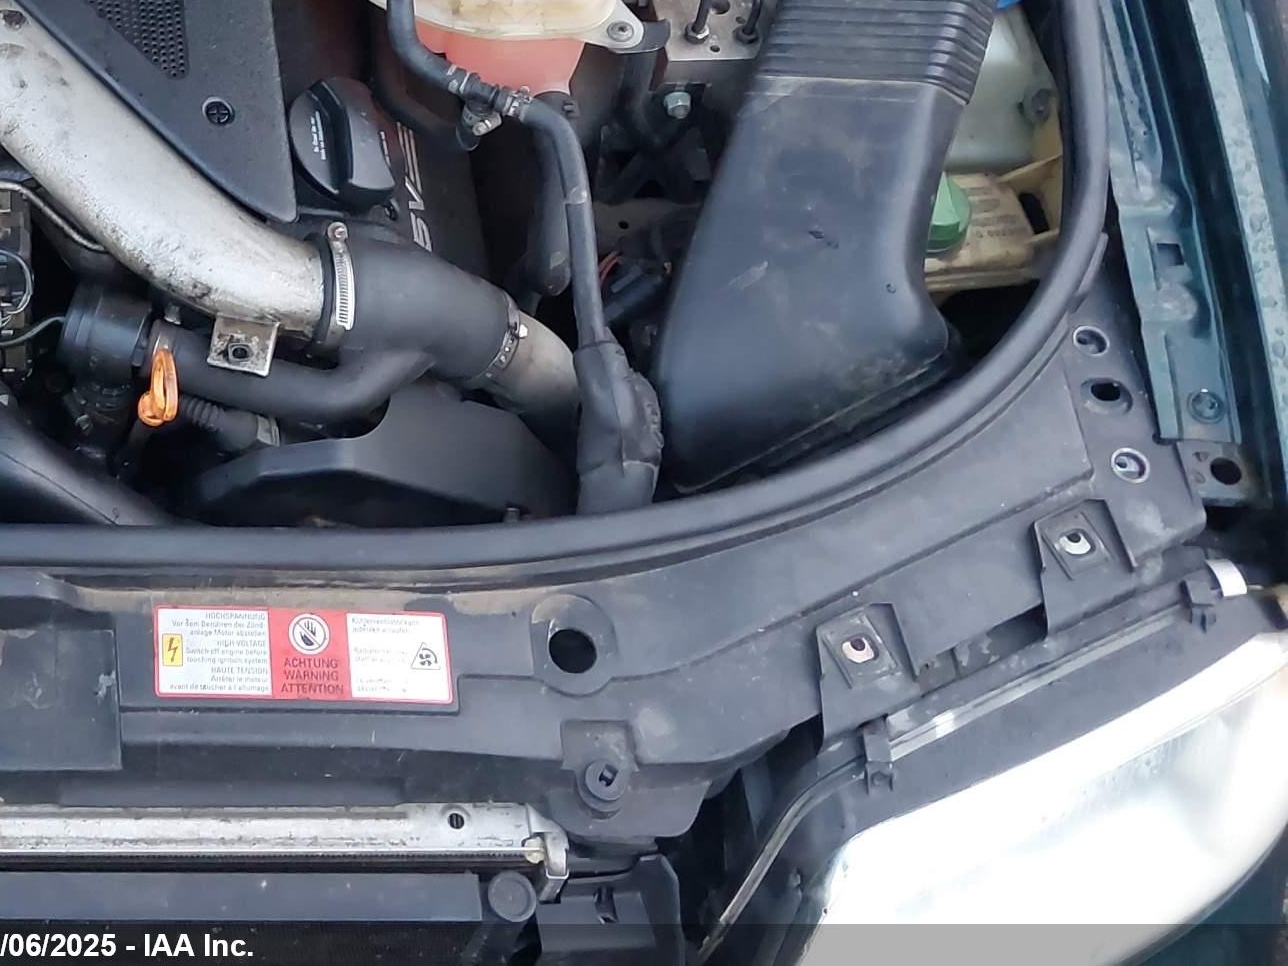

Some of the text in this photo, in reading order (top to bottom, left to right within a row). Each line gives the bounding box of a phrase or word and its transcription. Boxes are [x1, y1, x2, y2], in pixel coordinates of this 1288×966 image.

[172, 619, 183, 627] Vor
[237, 640, 266, 648] VOLTAGE
[284, 657, 338, 669] ACHTUNG
[284, 669, 339, 681] WARNING
[281, 682, 344, 694] ATTENTION
